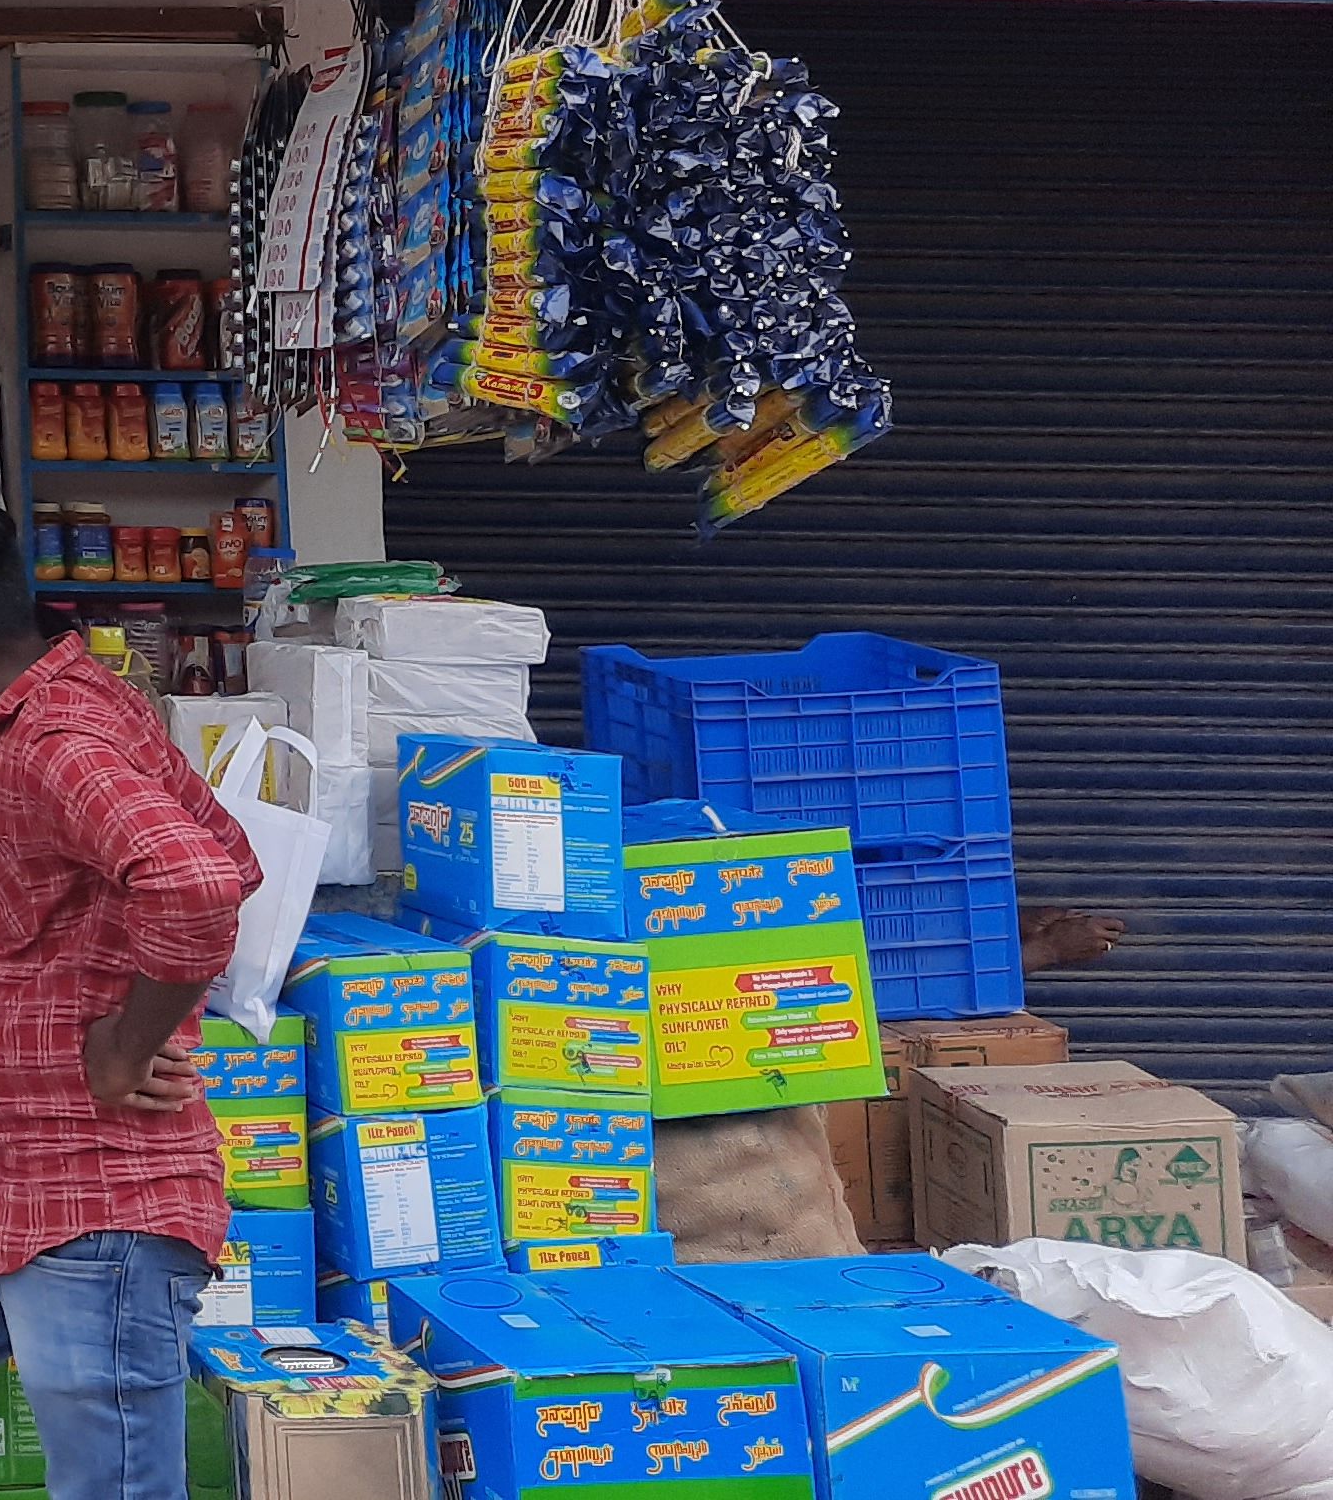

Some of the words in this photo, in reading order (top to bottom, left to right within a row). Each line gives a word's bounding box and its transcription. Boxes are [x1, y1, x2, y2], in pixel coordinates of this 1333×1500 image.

[508, 777, 527, 790] 500
[459, 822, 474, 843] 25
[655, 983, 682, 997] WHY
[659, 1000, 723, 1016] PHYSICALLY
[726, 994, 771, 1010] REFINED
[662, 1018, 729, 1035] SUNFLOWER
[665, 1041, 687, 1054] OIL?
[1064, 1213, 1202, 1248] ARYA
